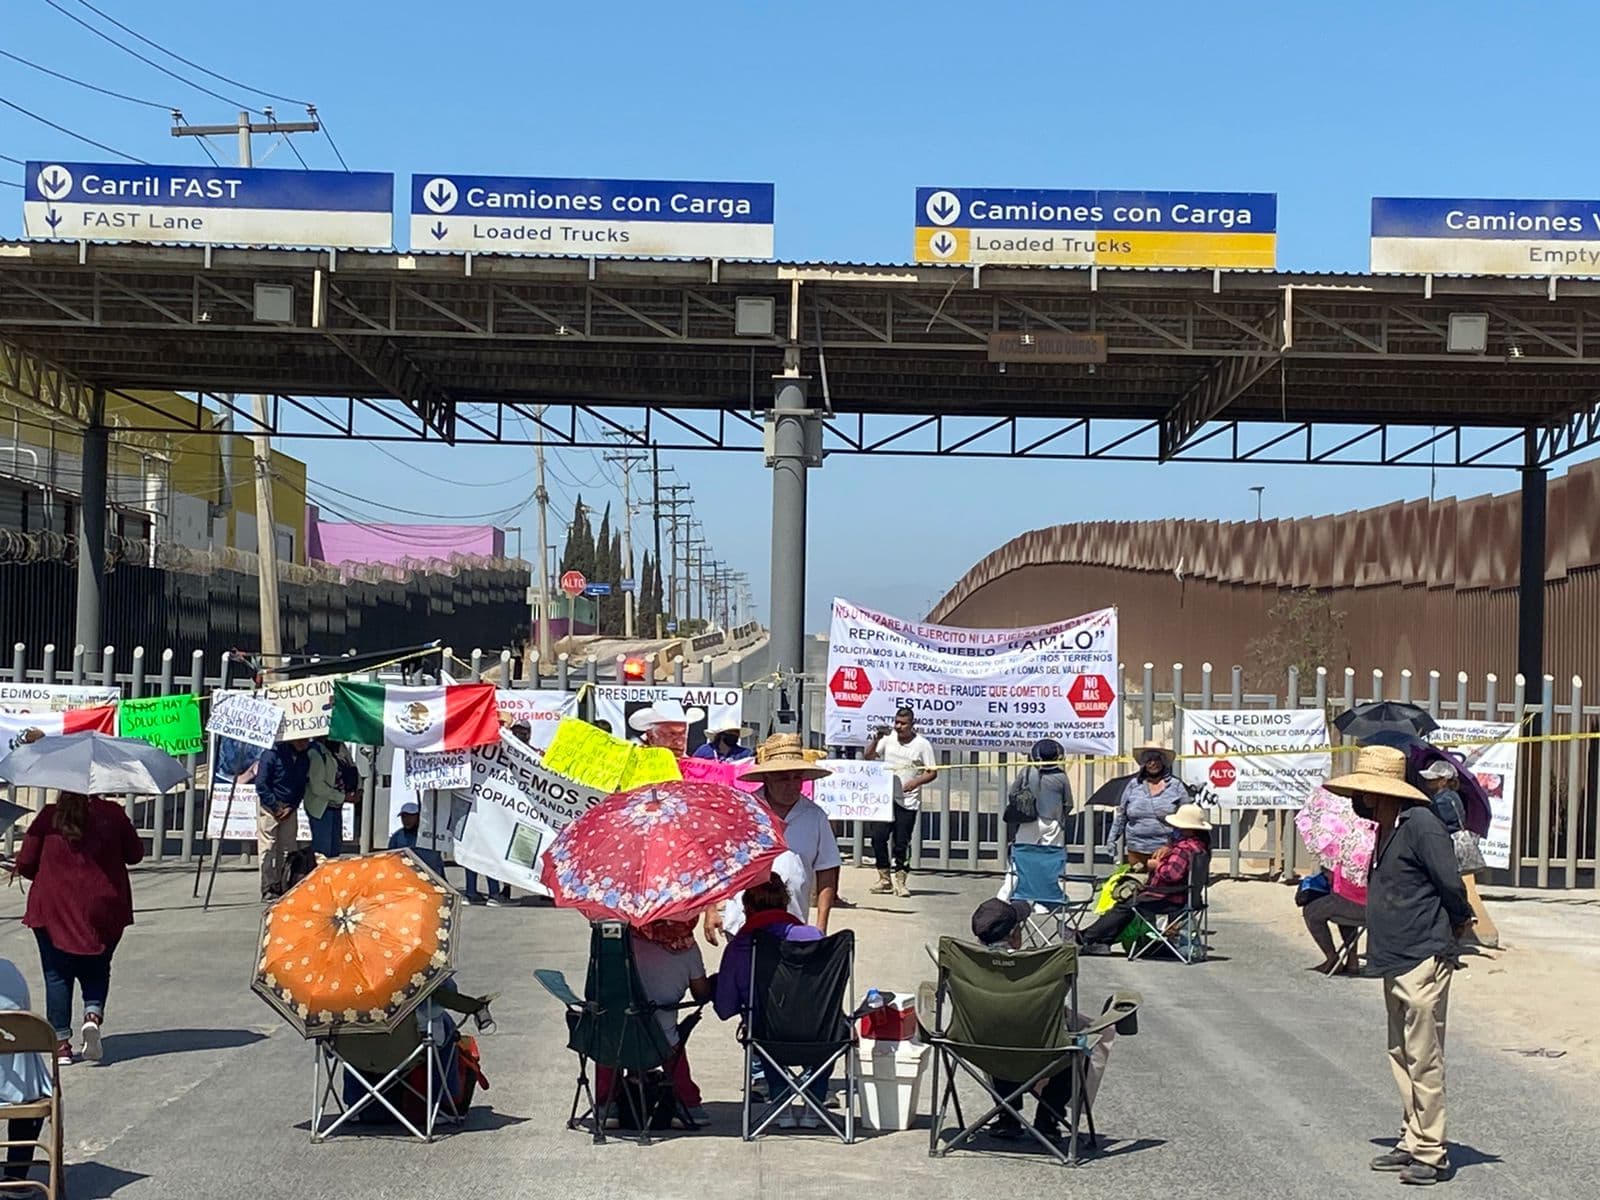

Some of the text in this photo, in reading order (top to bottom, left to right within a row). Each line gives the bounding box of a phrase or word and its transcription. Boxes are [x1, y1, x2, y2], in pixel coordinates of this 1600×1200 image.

[81, 174, 242, 199] Carril FAST
[465, 187, 752, 218] Camiones con Carga
[82, 211, 204, 230] FAST Lane
[968, 200, 1252, 229] Camiones con Carga
[1445, 210, 1583, 232] Camiones
[473, 223, 630, 242] Loaded Trucks
[975, 236, 1131, 254] Loaded Trucks
[1529, 247, 1600, 265] Empty
[562, 578, 585, 588] ALTO
[903, 622, 916, 635] AL
[917, 626, 967, 644] EJERCITO
[969, 634, 980, 644] NI
[981, 634, 995, 645] LA
[833, 645, 893, 658] SOLICITAMOS
[894, 650, 907, 659] LA
[1062, 653, 1113, 662] TERRENOS
[937, 648, 996, 658] PUEBLO
[1017, 665, 1044, 675] LOMAS
[1046, 665, 1060, 675] DEL
[877, 680, 1063, 698] JUSTICIA POR EL FRAUDE QUE COMETIO EL
[1084, 676, 1098, 689] NO
[1, 688, 51, 700] EDIMOS
[597, 687, 738, 712] PRESIDENTE AMLO
[1081, 689, 1100, 701] MAS
[292, 700, 314, 715] NO
[529, 701, 536, 710] Y
[987, 701, 1008, 714] EN
[1015, 701, 1047, 714] 1993
[126, 713, 180, 732] SOLUCION
[935, 718, 949, 727] DE
[950, 719, 983, 728] BUENA
[999, 721, 1014, 729] NO
[1016, 721, 1049, 729] SOMOS
[1053, 721, 1105, 730] INVASORES
[1213, 714, 1292, 725] LE PEDIMOS
[943, 727, 964, 736] QUE
[965, 729, 1011, 738] PAGAMOS
[1012, 730, 1025, 739] AL
[1026, 730, 1063, 739] ESTADO
[1064, 731, 1072, 739] Y
[1073, 731, 1116, 740] ESTAMOS
[1225, 729, 1260, 737] MANUEL
[1260, 729, 1287, 737] LOPEZ
[958, 738, 1002, 747] NUESTRO
[1193, 739, 1229, 756] NO
[1209, 769, 1236, 778] ALTO
